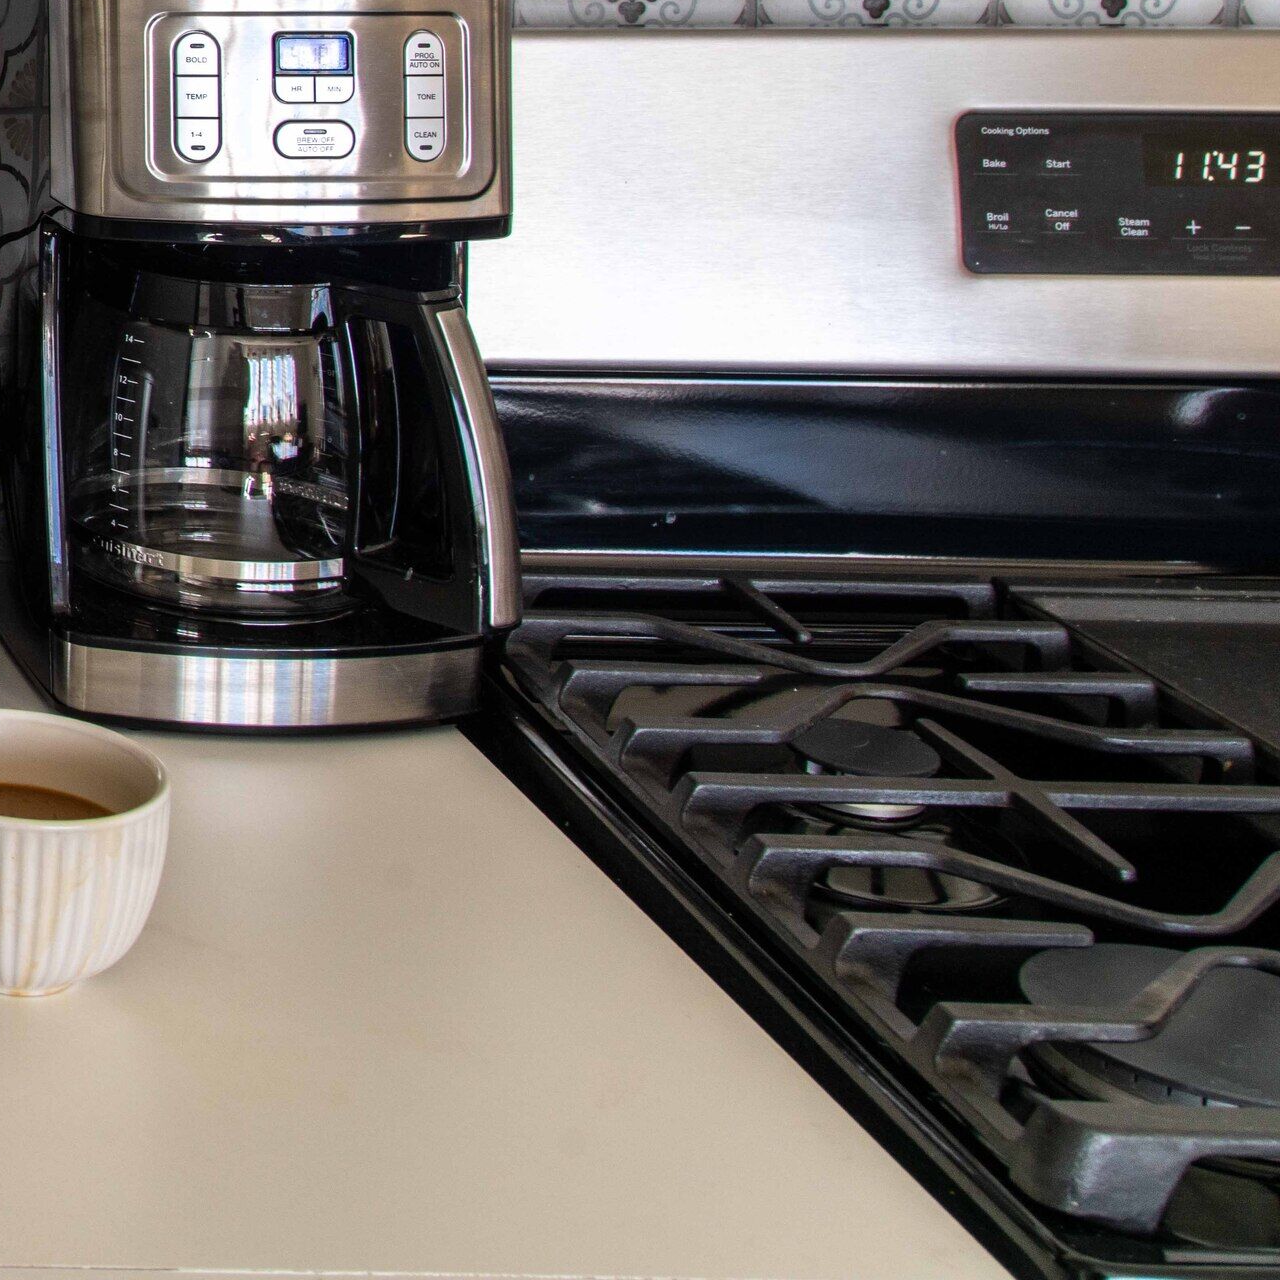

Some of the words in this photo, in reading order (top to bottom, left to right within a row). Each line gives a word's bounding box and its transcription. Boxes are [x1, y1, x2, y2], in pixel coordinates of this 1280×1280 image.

[981, 127, 1015, 136] Cooking
[1015, 126, 1050, 136] Options
[982, 159, 1007, 168] Bake
[1045, 159, 1072, 169] Start
[1175, 150, 1266, 183] 11:43
[986, 212, 1009, 221] Broil
[1045, 208, 1078, 218] Cancel
[1054, 222, 1070, 231] Off
[1118, 217, 1150, 227] Steam
[988, 223, 1009, 231] Hi/Lo
[1120, 227, 1149, 236] Clean
[124, 334, 134, 343] 14
[119, 375, 128, 384] 12
[114, 412, 123, 421] 10
[113, 448, 118, 456] 8
[111, 484, 117, 492] 6
[111, 519, 116, 527] 4
